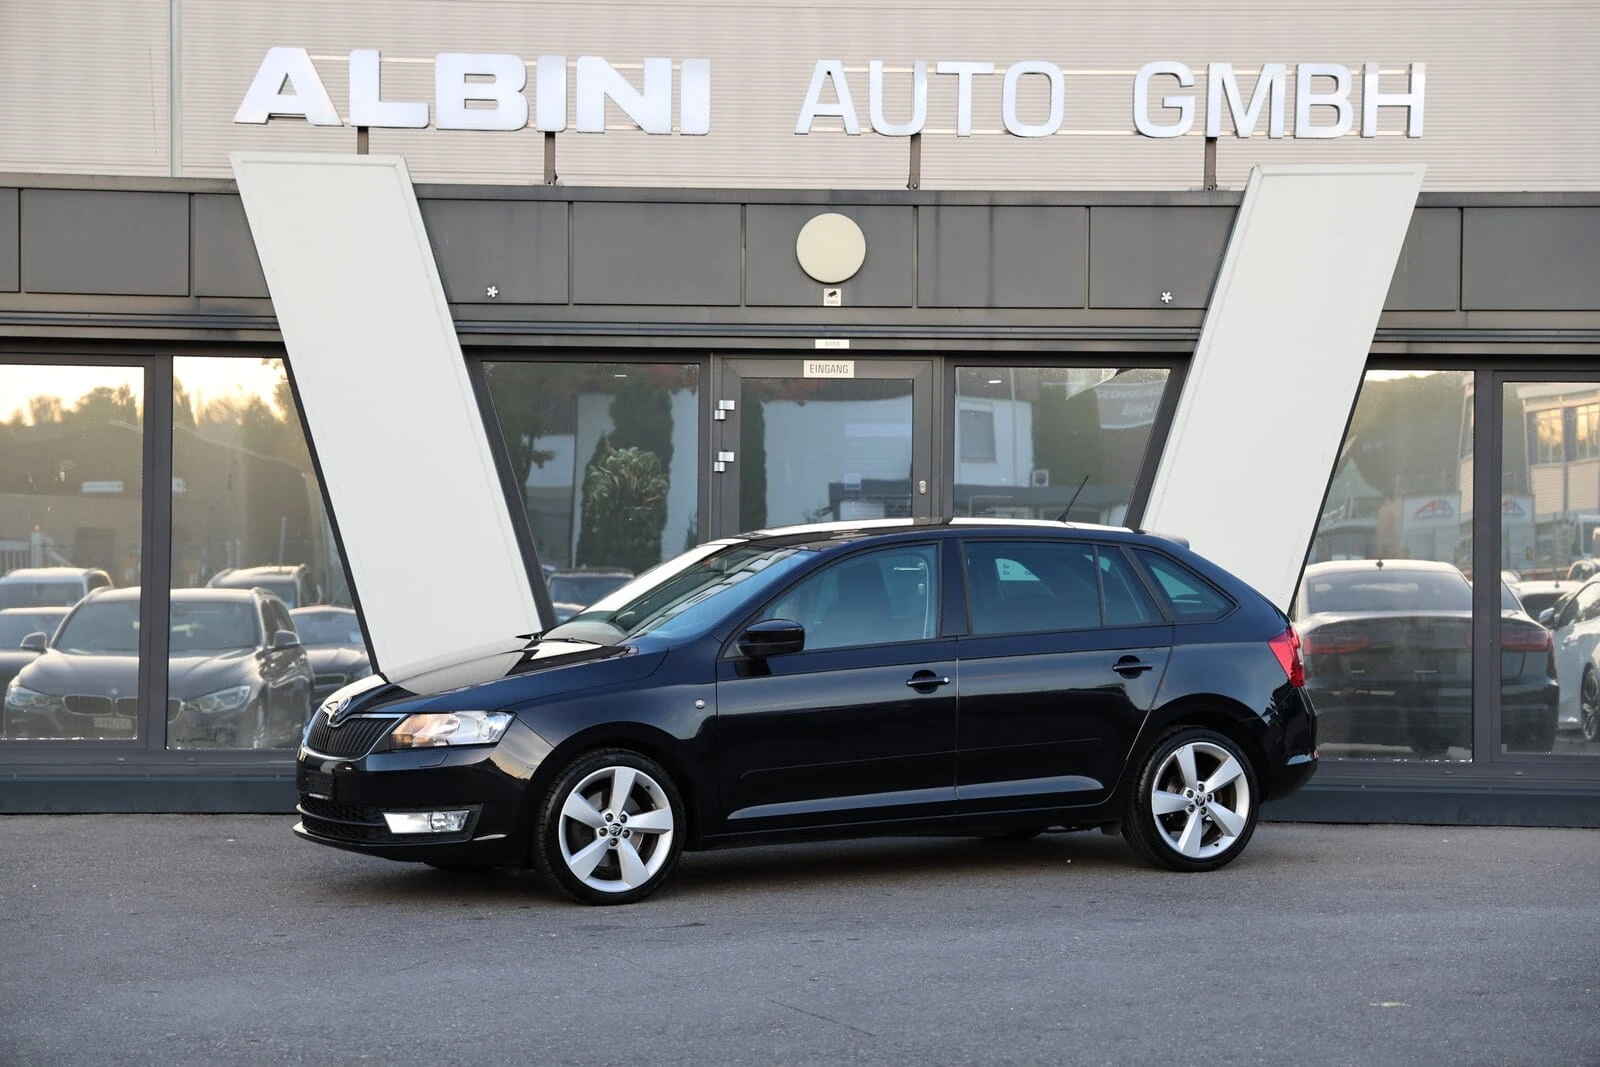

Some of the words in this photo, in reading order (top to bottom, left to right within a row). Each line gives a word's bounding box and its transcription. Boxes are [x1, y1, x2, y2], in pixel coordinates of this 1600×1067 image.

[234, 47, 711, 136] ALBINI
[795, 60, 1065, 138] AUTO
[1132, 61, 1426, 139] GMBH
[809, 364, 849, 374] EINGANG
